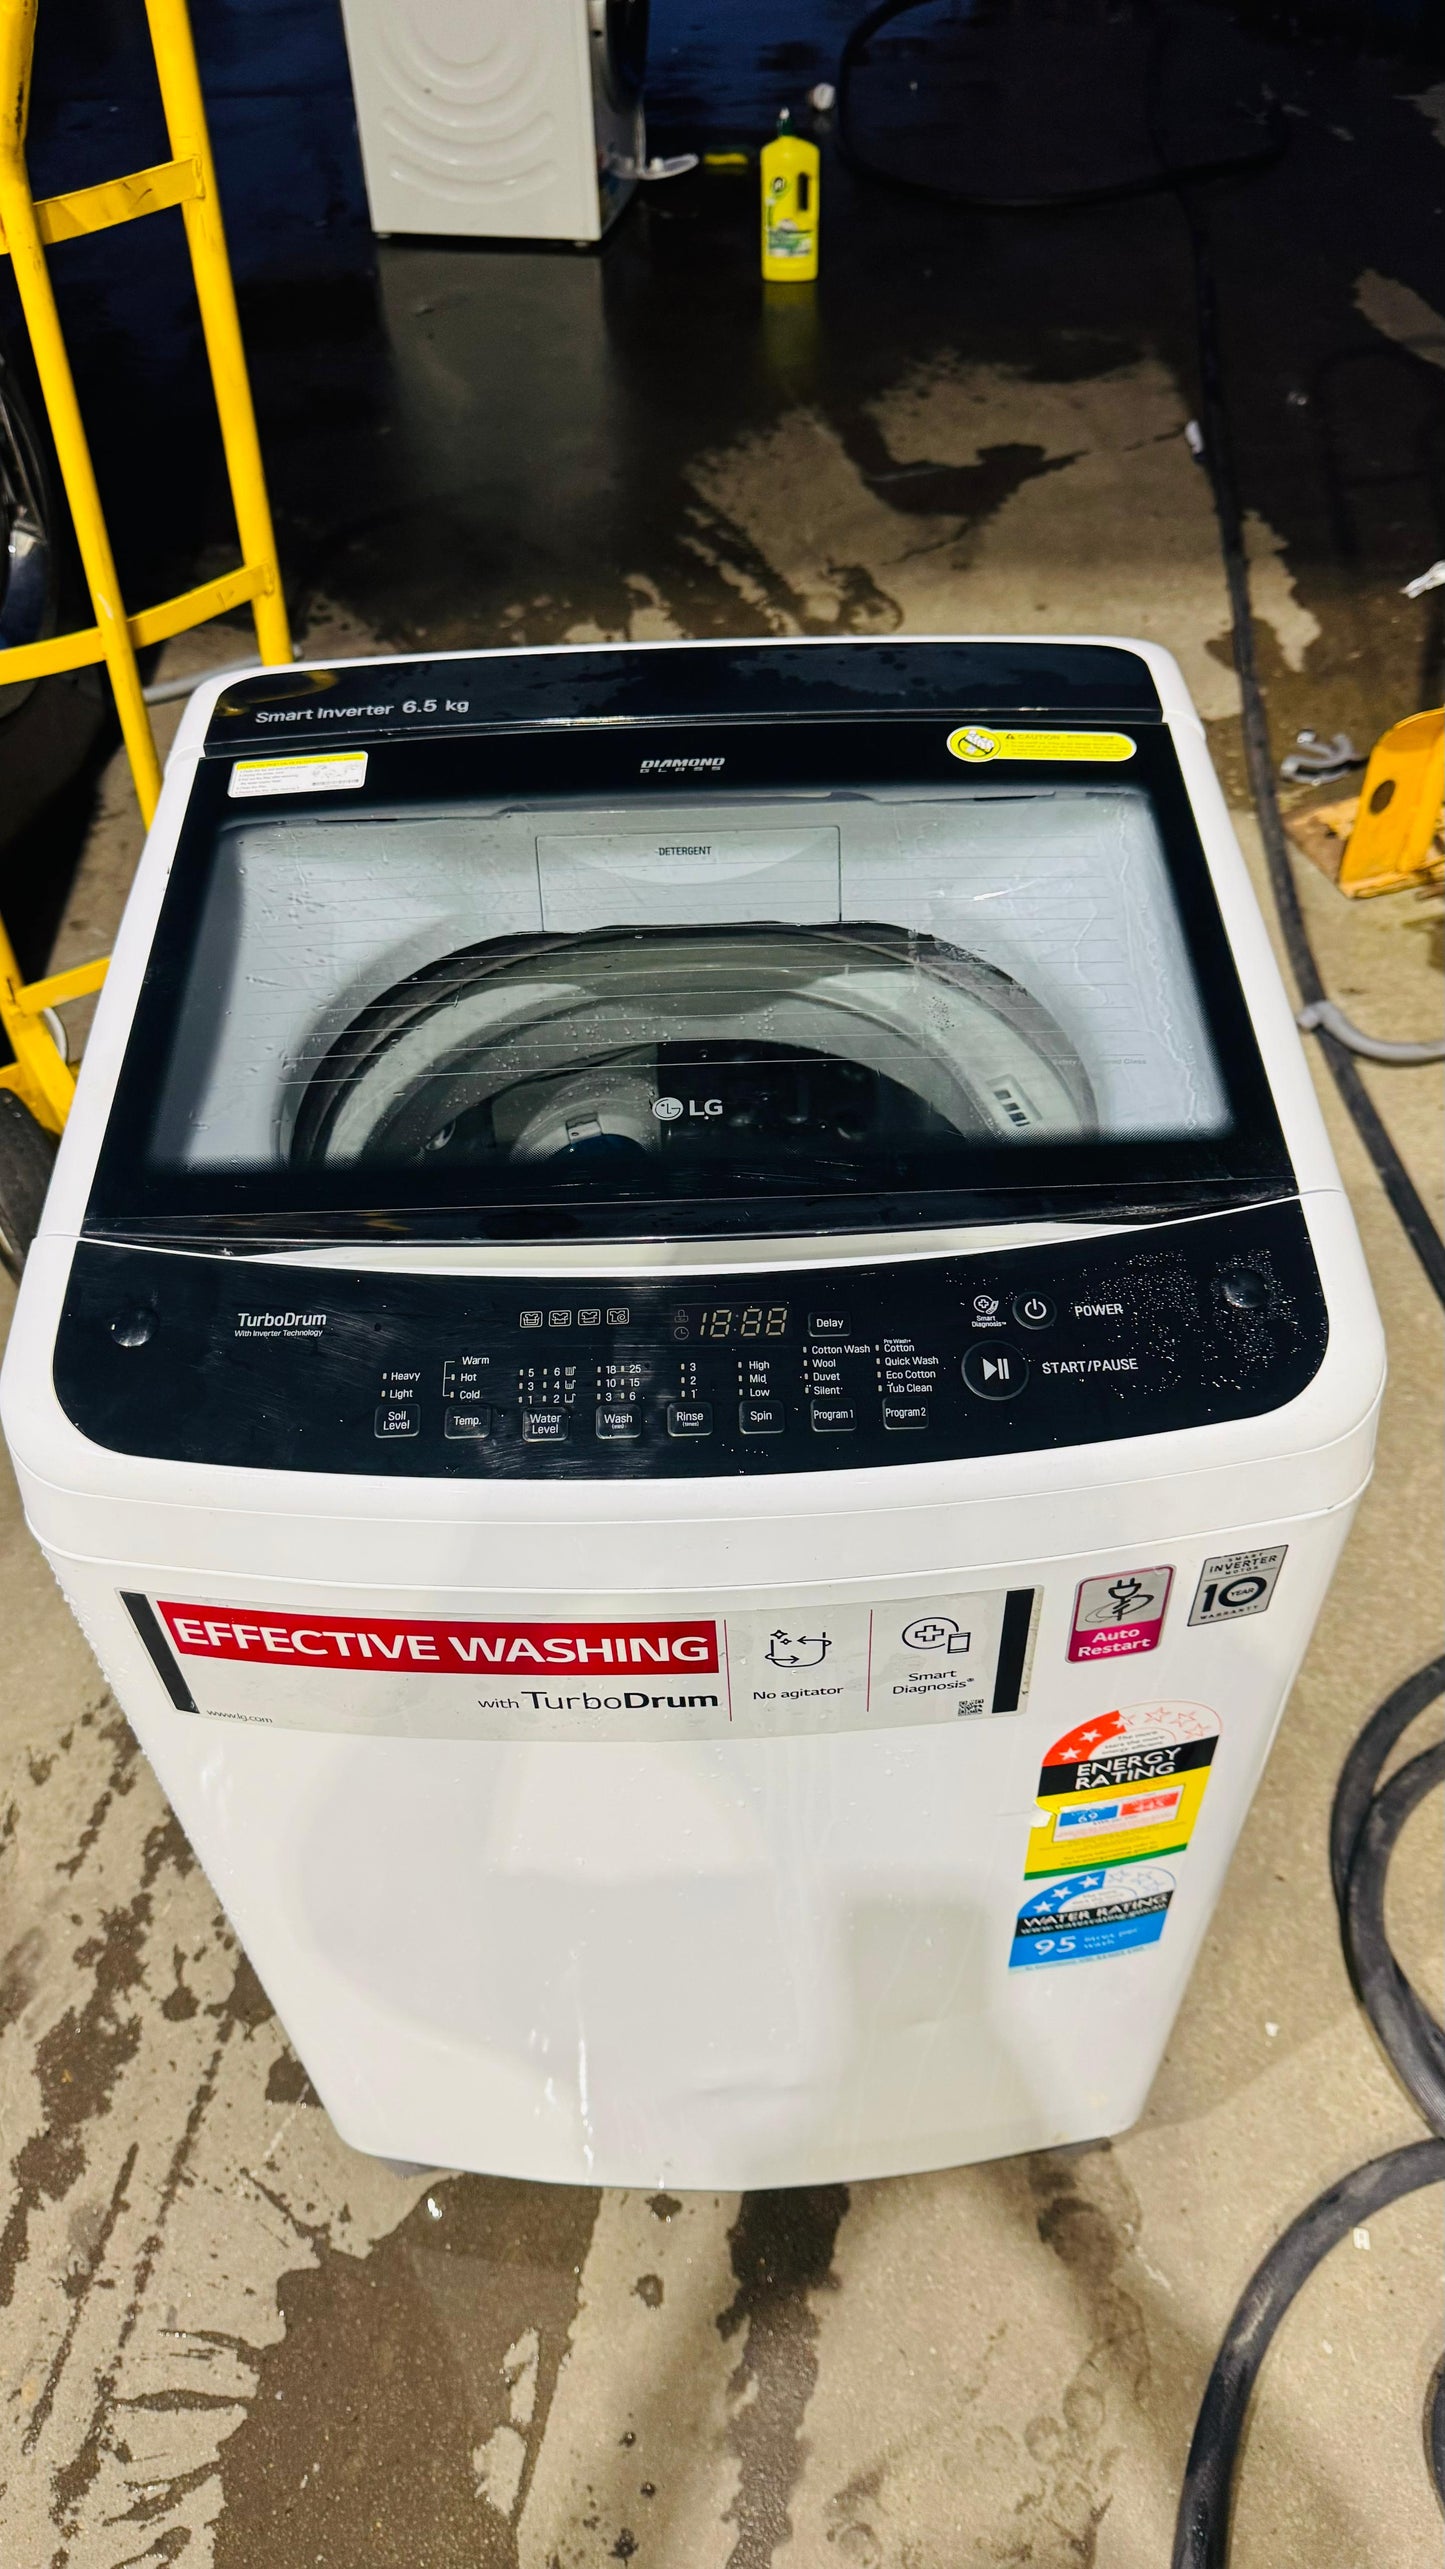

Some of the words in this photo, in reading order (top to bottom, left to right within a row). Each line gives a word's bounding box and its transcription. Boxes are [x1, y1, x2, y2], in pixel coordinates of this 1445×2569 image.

[255, 708, 314, 724] Smart
[317, 704, 395, 719] Inverter
[402, 699, 437, 714] 6.5
[445, 699, 470, 714] kg
[641, 758, 725, 768] DIAMOND
[658, 845, 712, 857] DETERGENT
[689, 1098, 724, 1117] LG
[1074, 1302, 1124, 1318] POWER
[238, 1312, 327, 1327] TurboDrum
[816, 1318, 844, 1329] Delay
[976, 1314, 997, 1322] Smart
[234, 1329, 252, 1337] With
[252, 1329, 281, 1337] Inverter
[283, 1329, 323, 1337] Technology
[811, 1345, 842, 1355] Cotton
[843, 1344, 871, 1354] Wash
[884, 1343, 915, 1353] Cotton
[462, 1355, 490, 1365] Warm
[749, 1360, 770, 1371] High
[812, 1358, 836, 1368] Wool
[885, 1356, 910, 1366] Quick
[911, 1356, 939, 1365] Wash
[605, 1365, 617, 1374] 18
[629, 1364, 642, 1373] 25
[689, 1362, 697, 1372] 3
[1042, 1357, 1139, 1375] START/PAUSE
[390, 1371, 421, 1382] Heavy
[460, 1372, 478, 1382] Hot
[527, 1368, 535, 1378] 5
[553, 1367, 561, 1376] 6
[750, 1373, 766, 1383] Mid
[813, 1372, 841, 1382] Duvet
[886, 1370, 904, 1380] Eco
[905, 1369, 936, 1379] Cotton
[527, 1382, 534, 1391] 3
[553, 1381, 561, 1390] 4
[605, 1379, 617, 1388] 10
[629, 1378, 641, 1387] 15
[689, 1376, 697, 1385] 2
[750, 1387, 770, 1397] Low
[813, 1385, 841, 1395] Silent
[887, 1383, 905, 1393] Tub
[906, 1383, 933, 1393] Clean
[389, 1388, 413, 1400] Light
[459, 1389, 481, 1400] Cold
[527, 1395, 534, 1404] 1
[553, 1394, 560, 1403] 2
[605, 1392, 612, 1401] 3
[629, 1392, 636, 1401] 6
[690, 1389, 697, 1399] 1
[387, 1410, 407, 1421] Soil
[529, 1413, 562, 1424] Water
[604, 1413, 633, 1424] Wash
[676, 1411, 704, 1422] Rinse
[750, 1410, 773, 1421] Spin
[813, 1409, 848, 1420] Program
[383, 1420, 410, 1431] Level
[453, 1415, 482, 1427] Temp.
[532, 1423, 559, 1434] Level
[1228, 1553, 1263, 1562] SMART
[1209, 1555, 1277, 1573] INVERTER
[1225, 1565, 1259, 1575] MOTOR
[1202, 1576, 1267, 1612] 10
[1231, 1587, 1255, 1597] YEAR
[1200, 1605, 1258, 1620] WARRANTY
[172, 1617, 440, 1661] EFFECTIVE
[447, 1636, 709, 1663] WASHING
[1092, 1627, 1140, 1643] Auto
[1078, 1638, 1151, 1657] Restart
[908, 1670, 958, 1682] Smart
[753, 1691, 777, 1700] No
[782, 1687, 844, 1700] agitator
[478, 1698, 520, 1709] with
[521, 1691, 718, 1709] TurboDrum
[206, 1710, 273, 1723] www.lg.com
[1076, 1747, 1182, 1777] ENERGY
[1075, 1761, 1176, 1790] RATING
[1077, 1812, 1099, 1824] 69
[1023, 1911, 1090, 1927] WATER
[1096, 1894, 1169, 1919] RATING
[1034, 1935, 1077, 1956] 95
